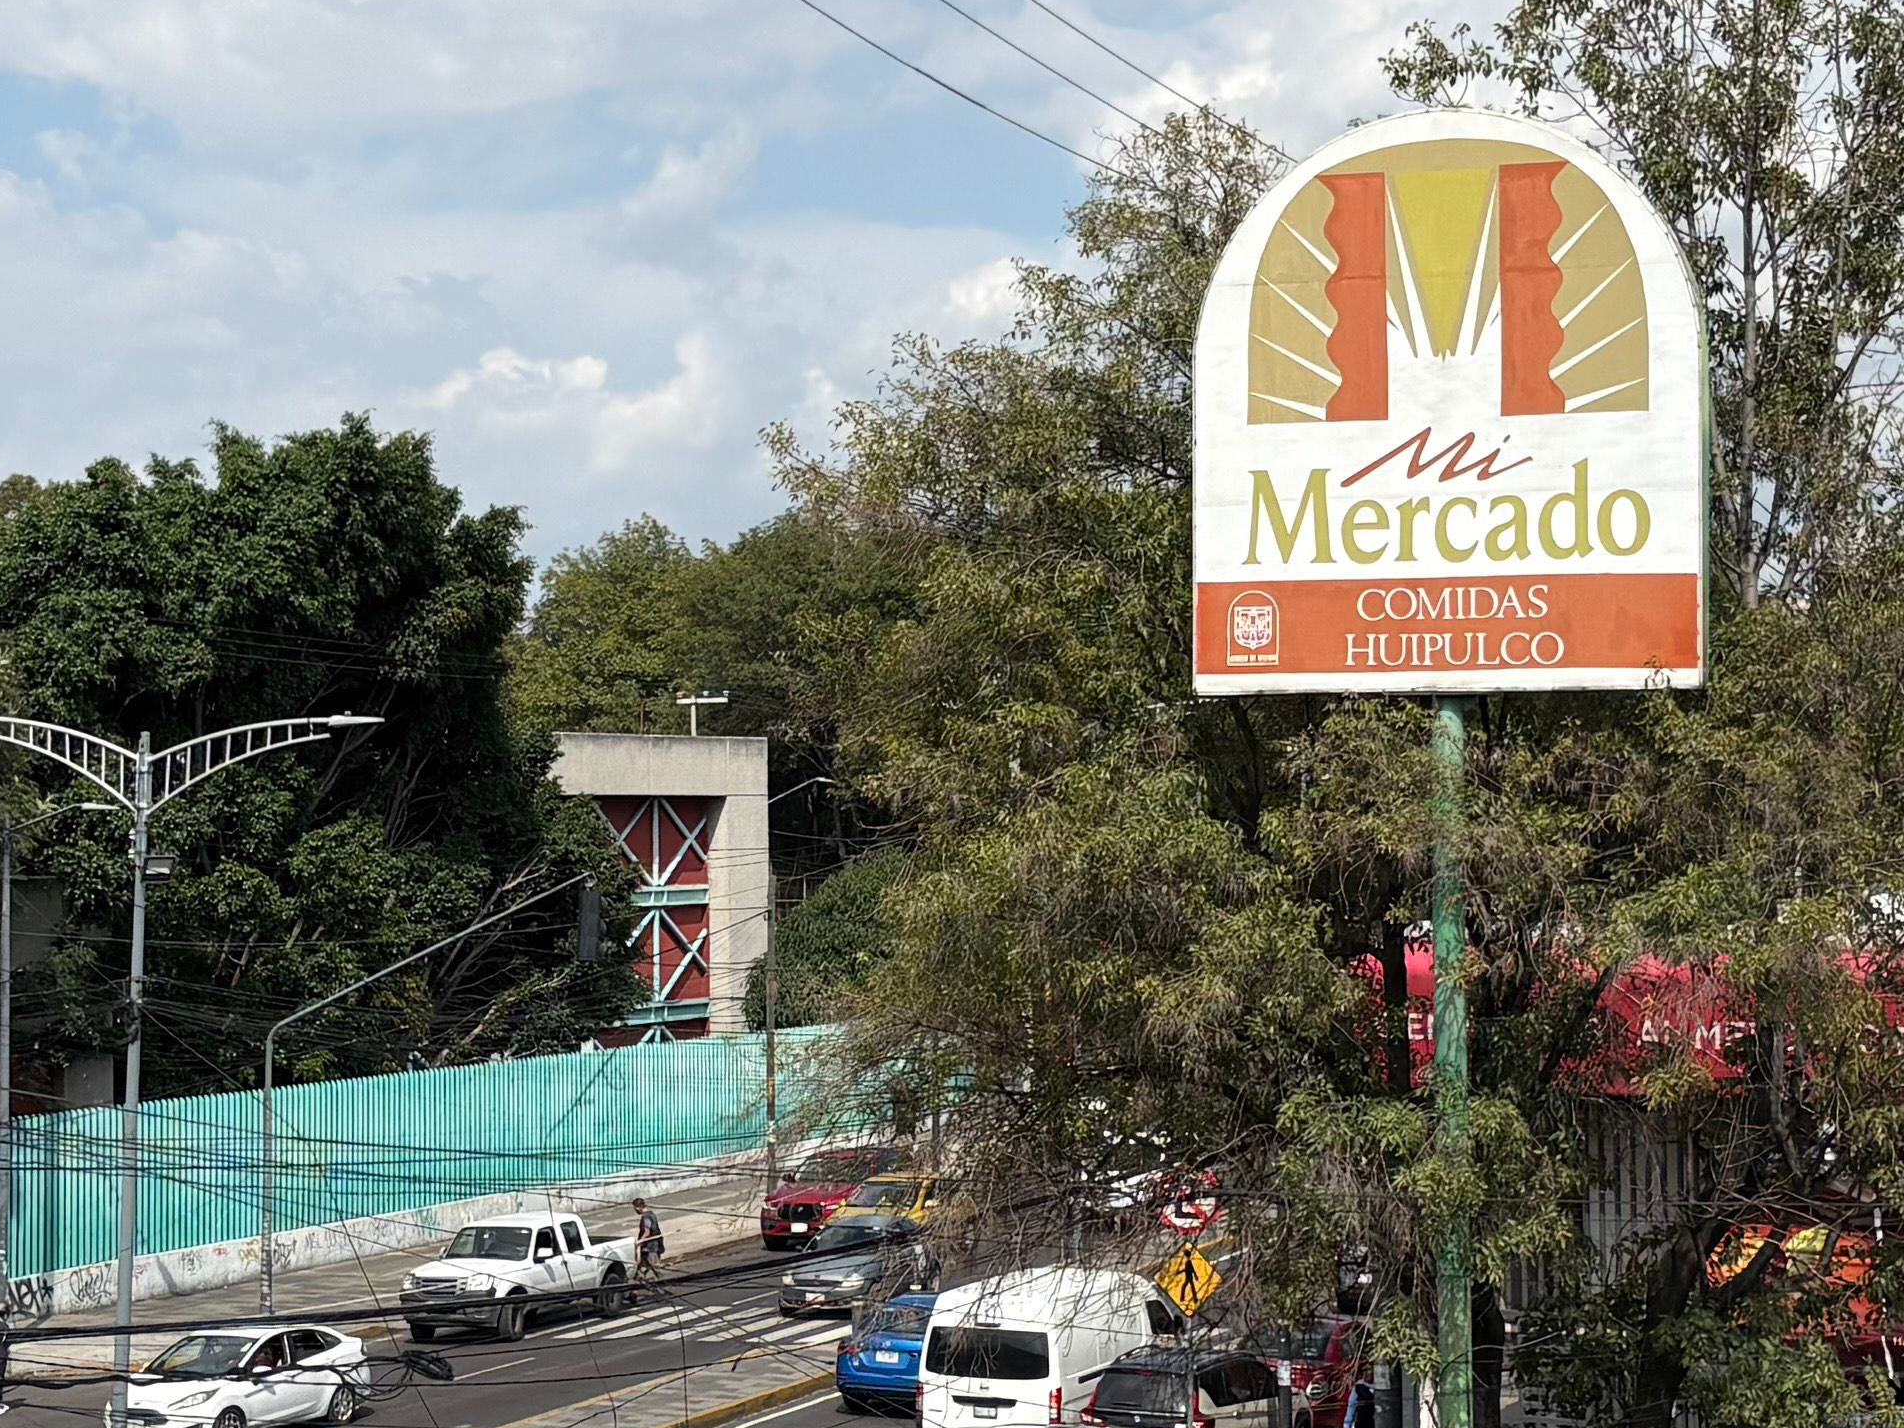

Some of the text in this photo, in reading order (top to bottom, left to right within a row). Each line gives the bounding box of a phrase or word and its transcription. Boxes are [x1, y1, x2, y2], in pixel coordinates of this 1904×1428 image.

[1341, 426, 1533, 488] Mi
[1242, 457, 1651, 565] Mercado
[1356, 585, 1549, 622] COMIDAS
[1344, 631, 1565, 667] HUIPULCO
